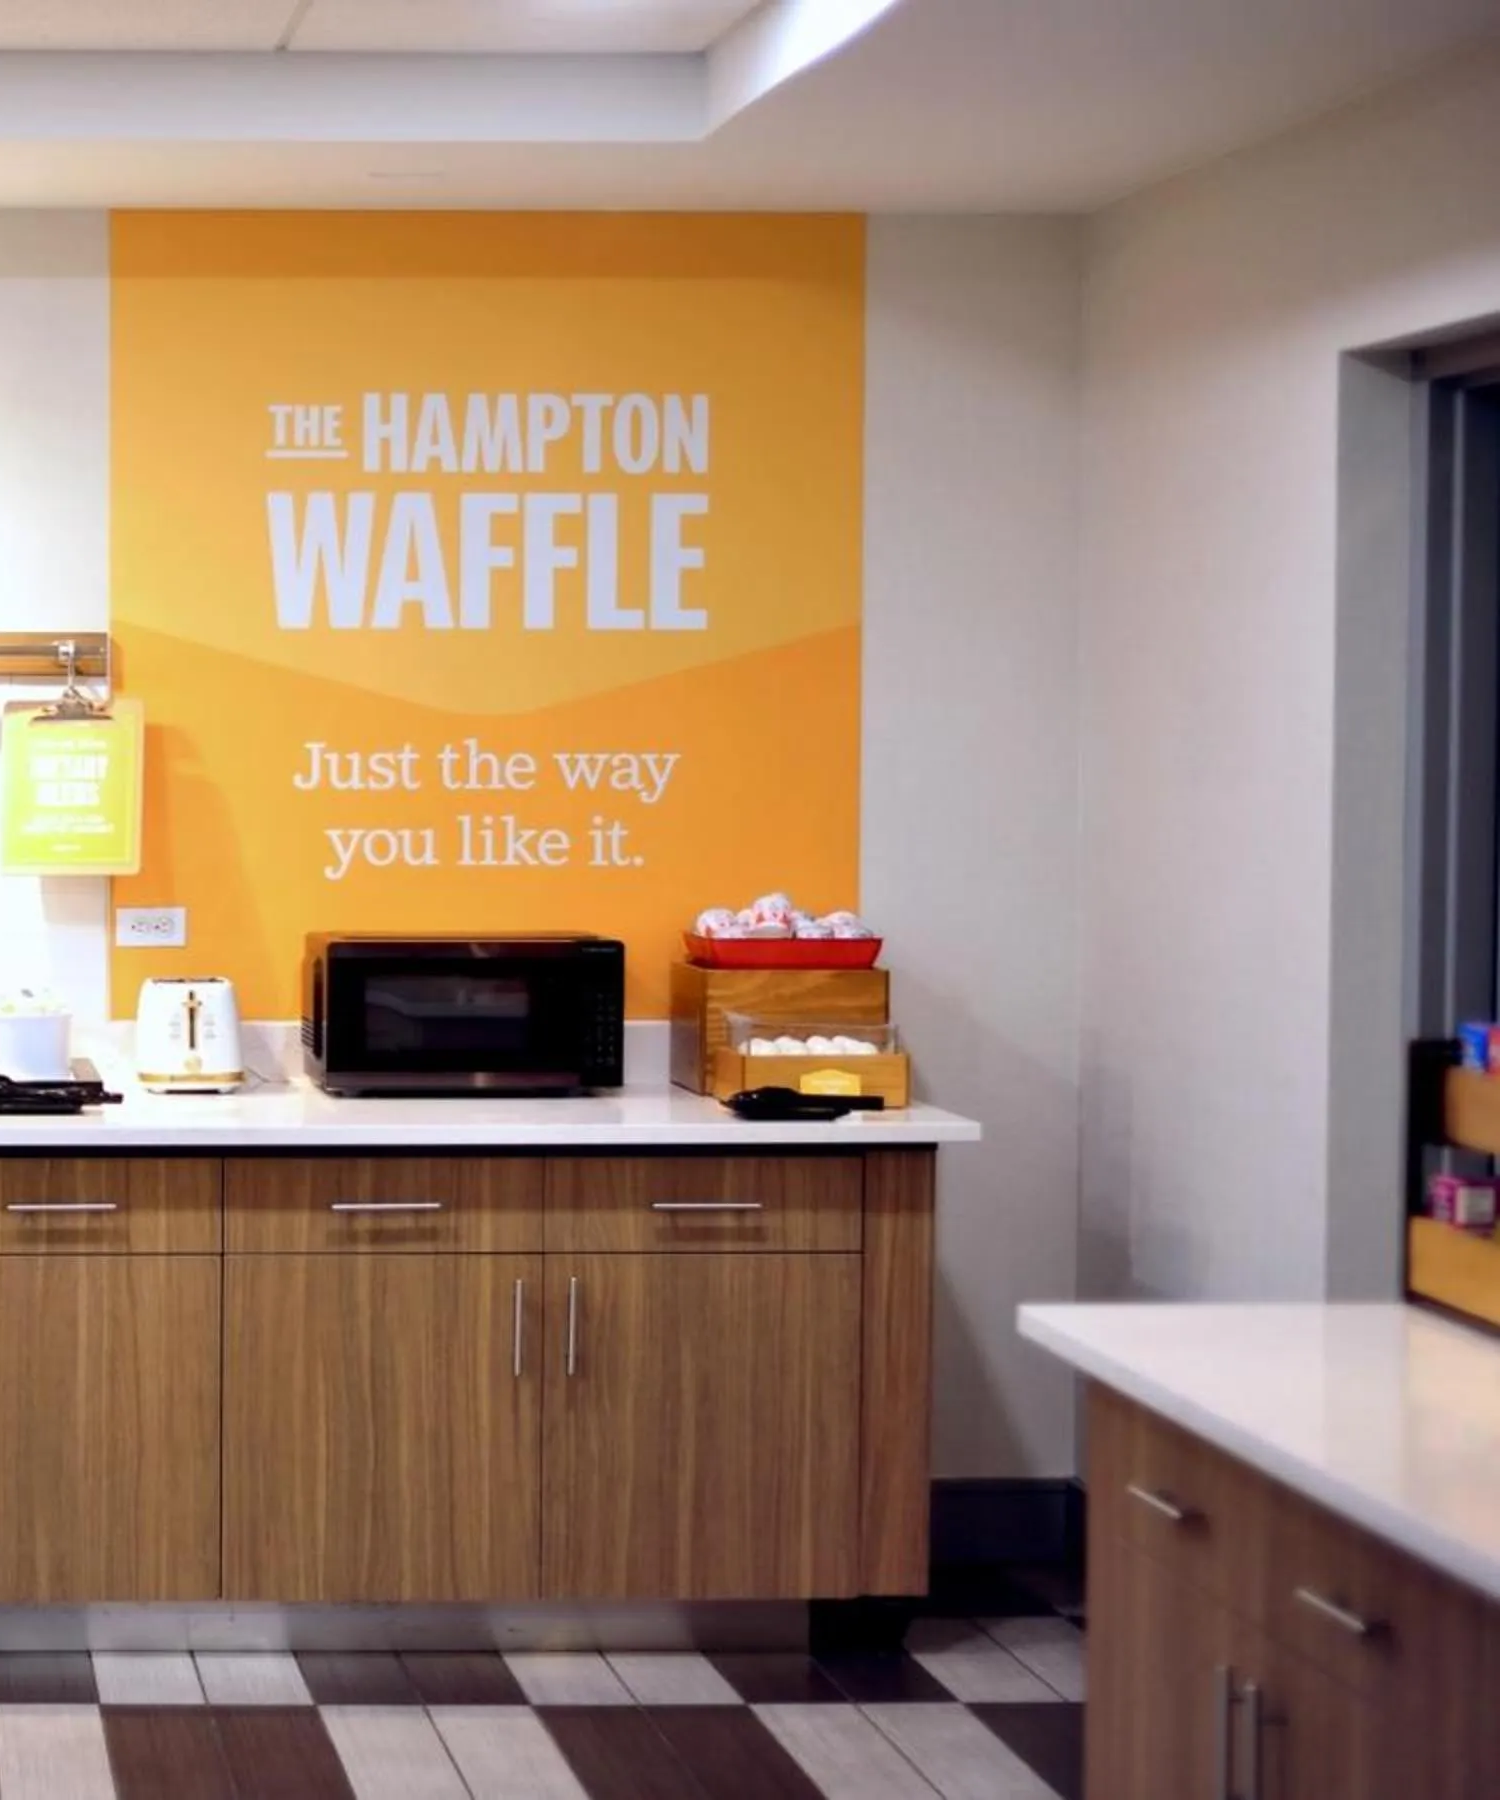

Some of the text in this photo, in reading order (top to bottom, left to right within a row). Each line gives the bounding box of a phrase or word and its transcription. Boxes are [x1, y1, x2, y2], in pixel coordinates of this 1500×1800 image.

[268, 392, 709, 474] THE HAMPTON
[265, 490, 709, 631] WAFFLE
[293, 738, 679, 803] Just the way
[324, 815, 644, 880] you like it.
